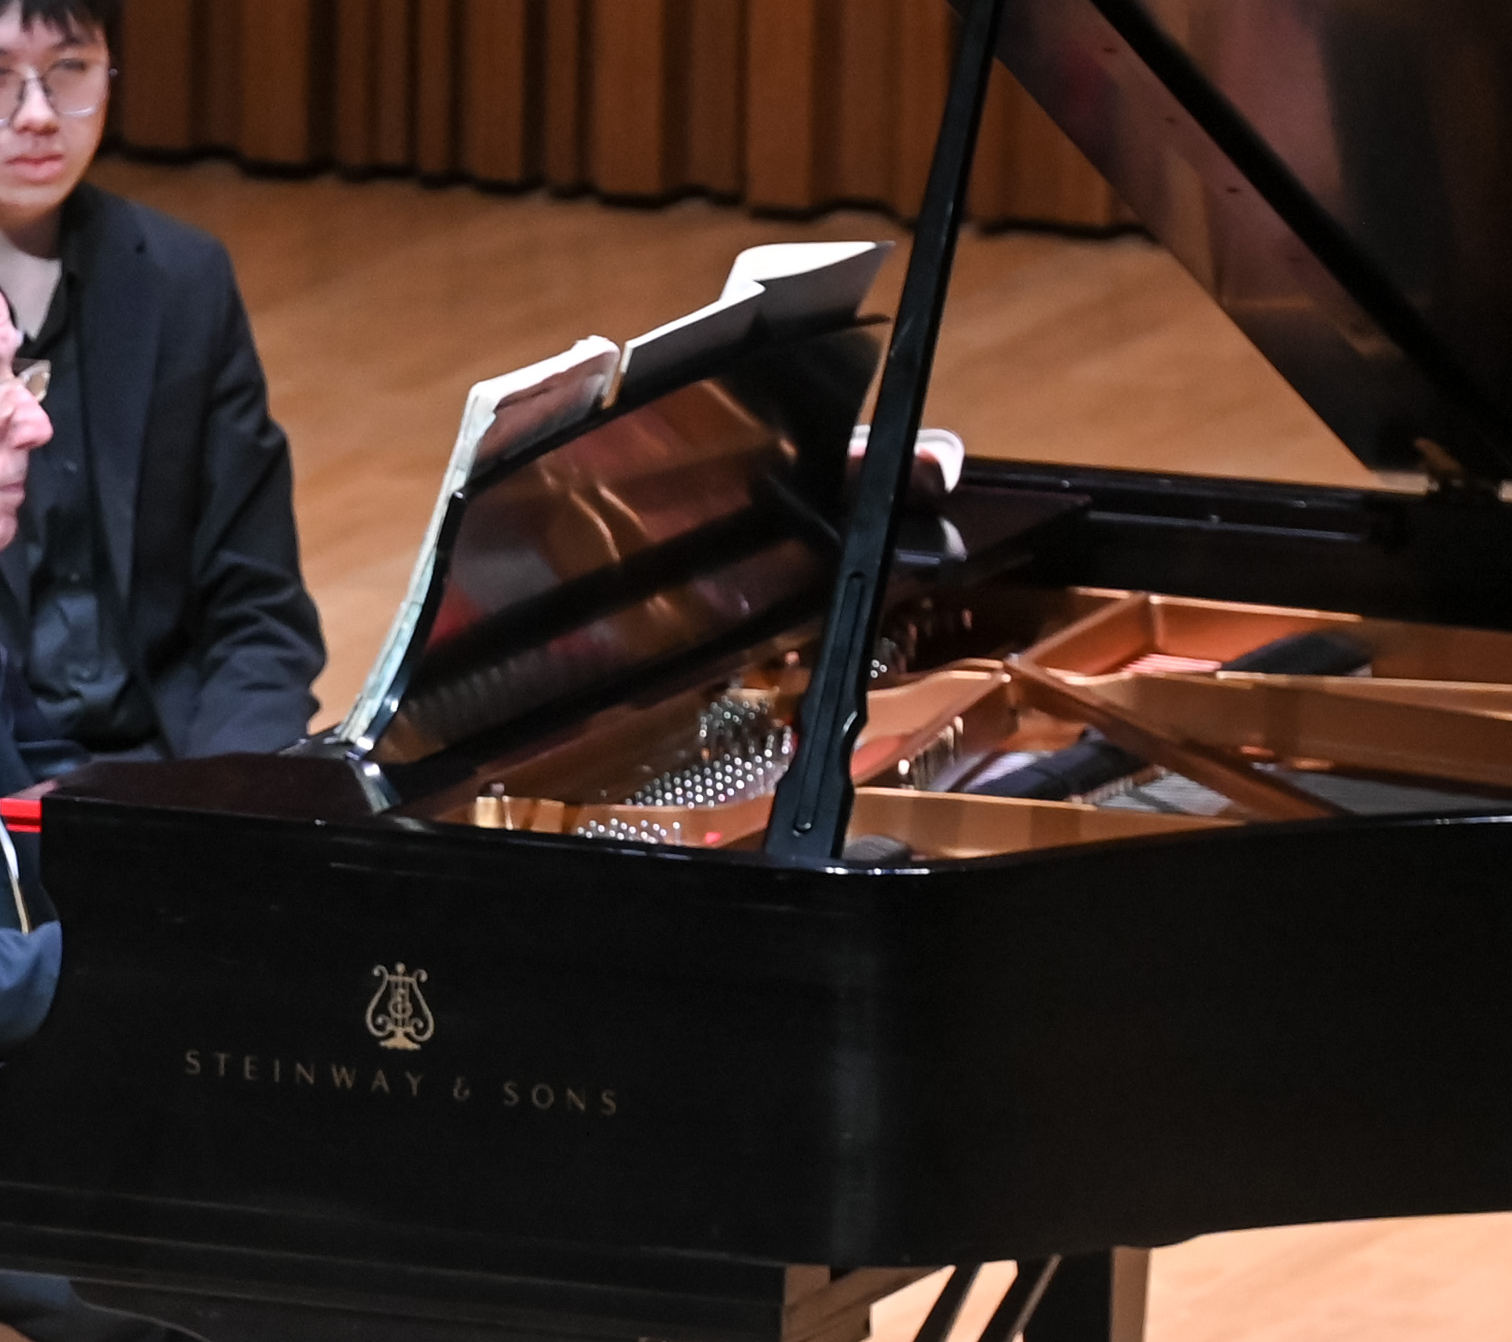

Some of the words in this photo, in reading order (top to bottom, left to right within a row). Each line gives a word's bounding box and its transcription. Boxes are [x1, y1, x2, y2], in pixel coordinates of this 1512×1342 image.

[184, 1049, 426, 1097] STEINWAY
[452, 1075, 472, 1100] &
[502, 1081, 620, 1116] SONS
